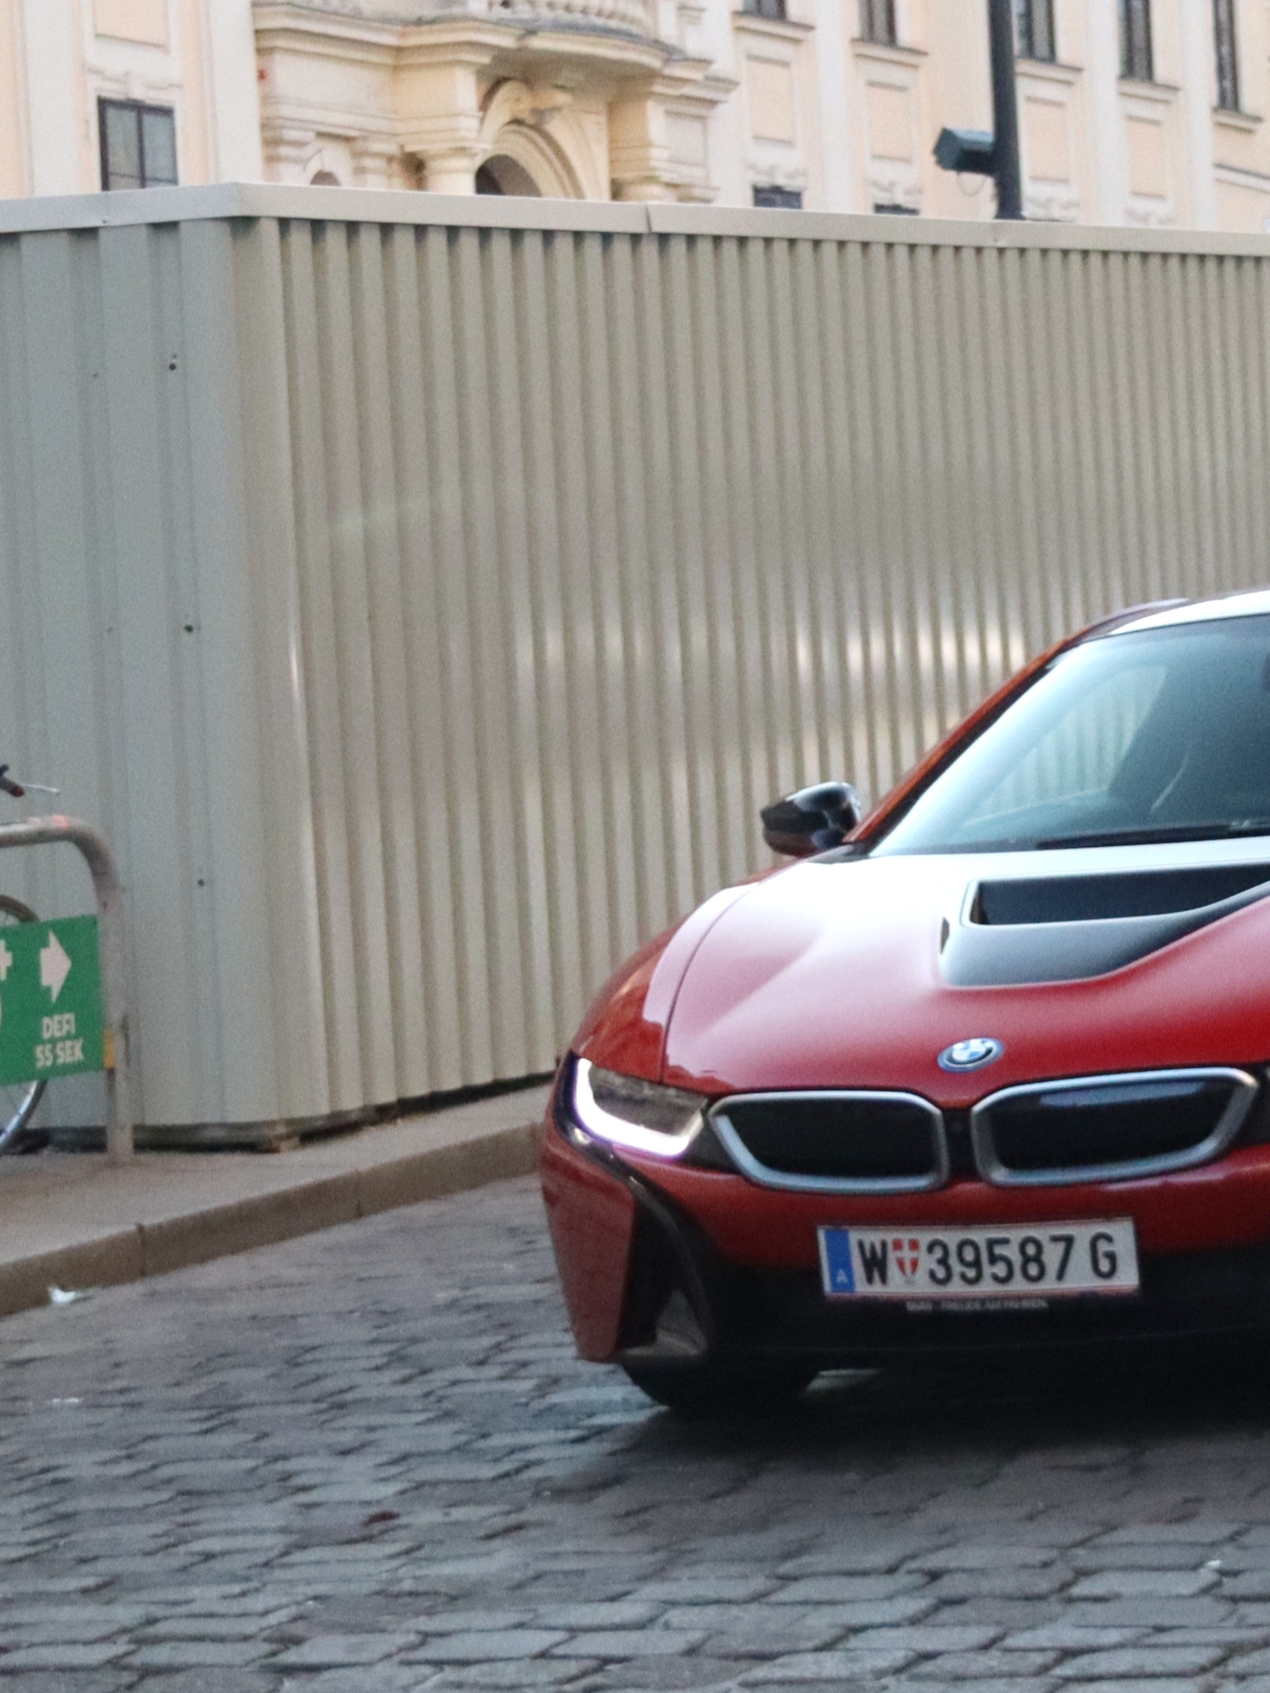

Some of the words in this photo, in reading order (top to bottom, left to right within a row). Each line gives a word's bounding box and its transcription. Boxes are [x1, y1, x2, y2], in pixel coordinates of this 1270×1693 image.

[42, 1012, 75, 1039] DEFI
[56, 1038, 84, 1064] SEK
[858, 1238, 888, 1285] W
[927, 1233, 1075, 1285] 39587
[1090, 1231, 1117, 1279] G
